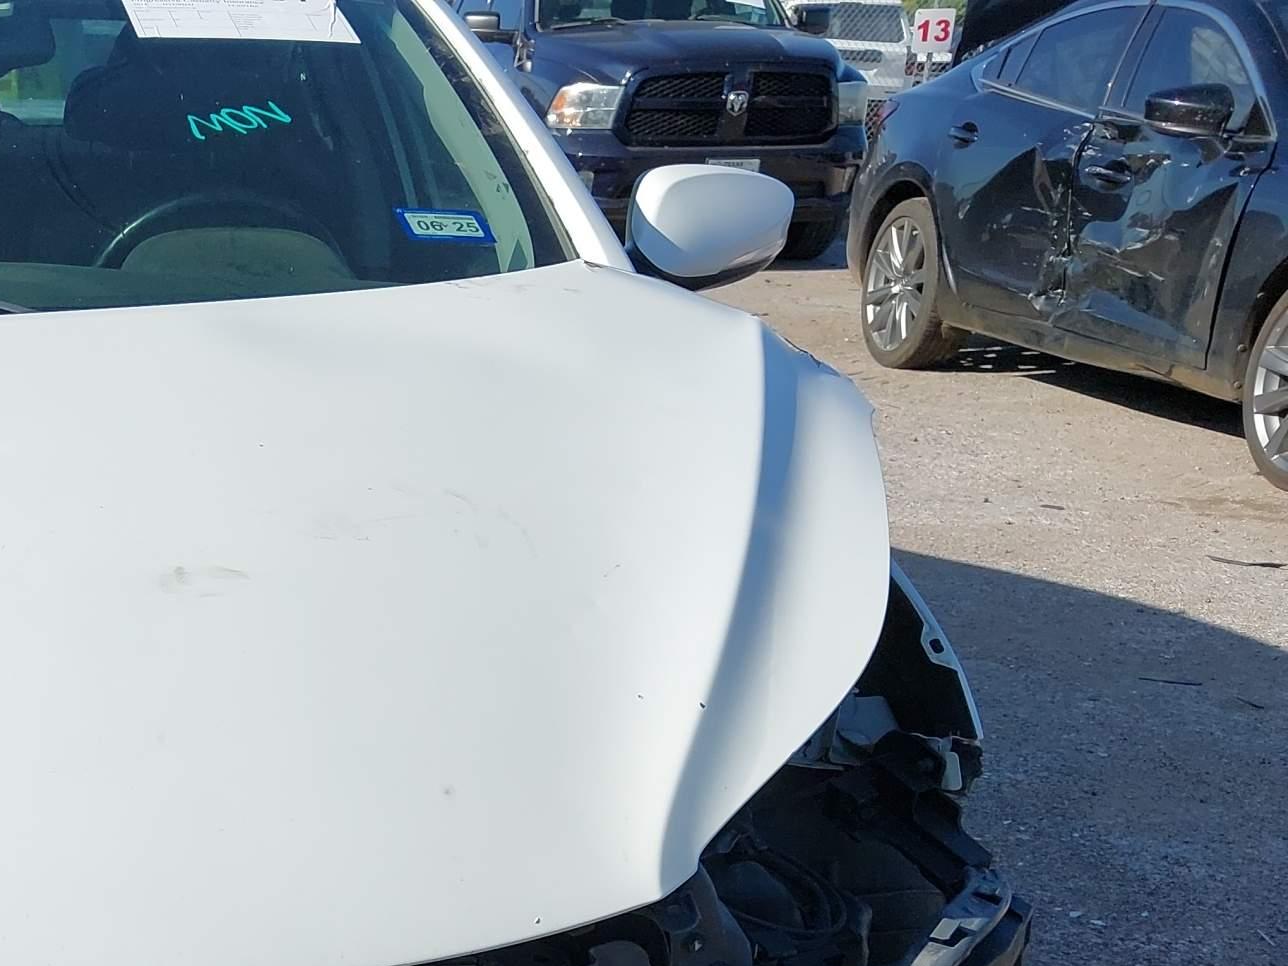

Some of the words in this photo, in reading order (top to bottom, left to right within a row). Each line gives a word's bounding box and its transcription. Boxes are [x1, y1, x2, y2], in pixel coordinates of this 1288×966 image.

[918, 19, 951, 42] 13
[416, 220, 444, 232] 06
[451, 221, 480, 233] 25
